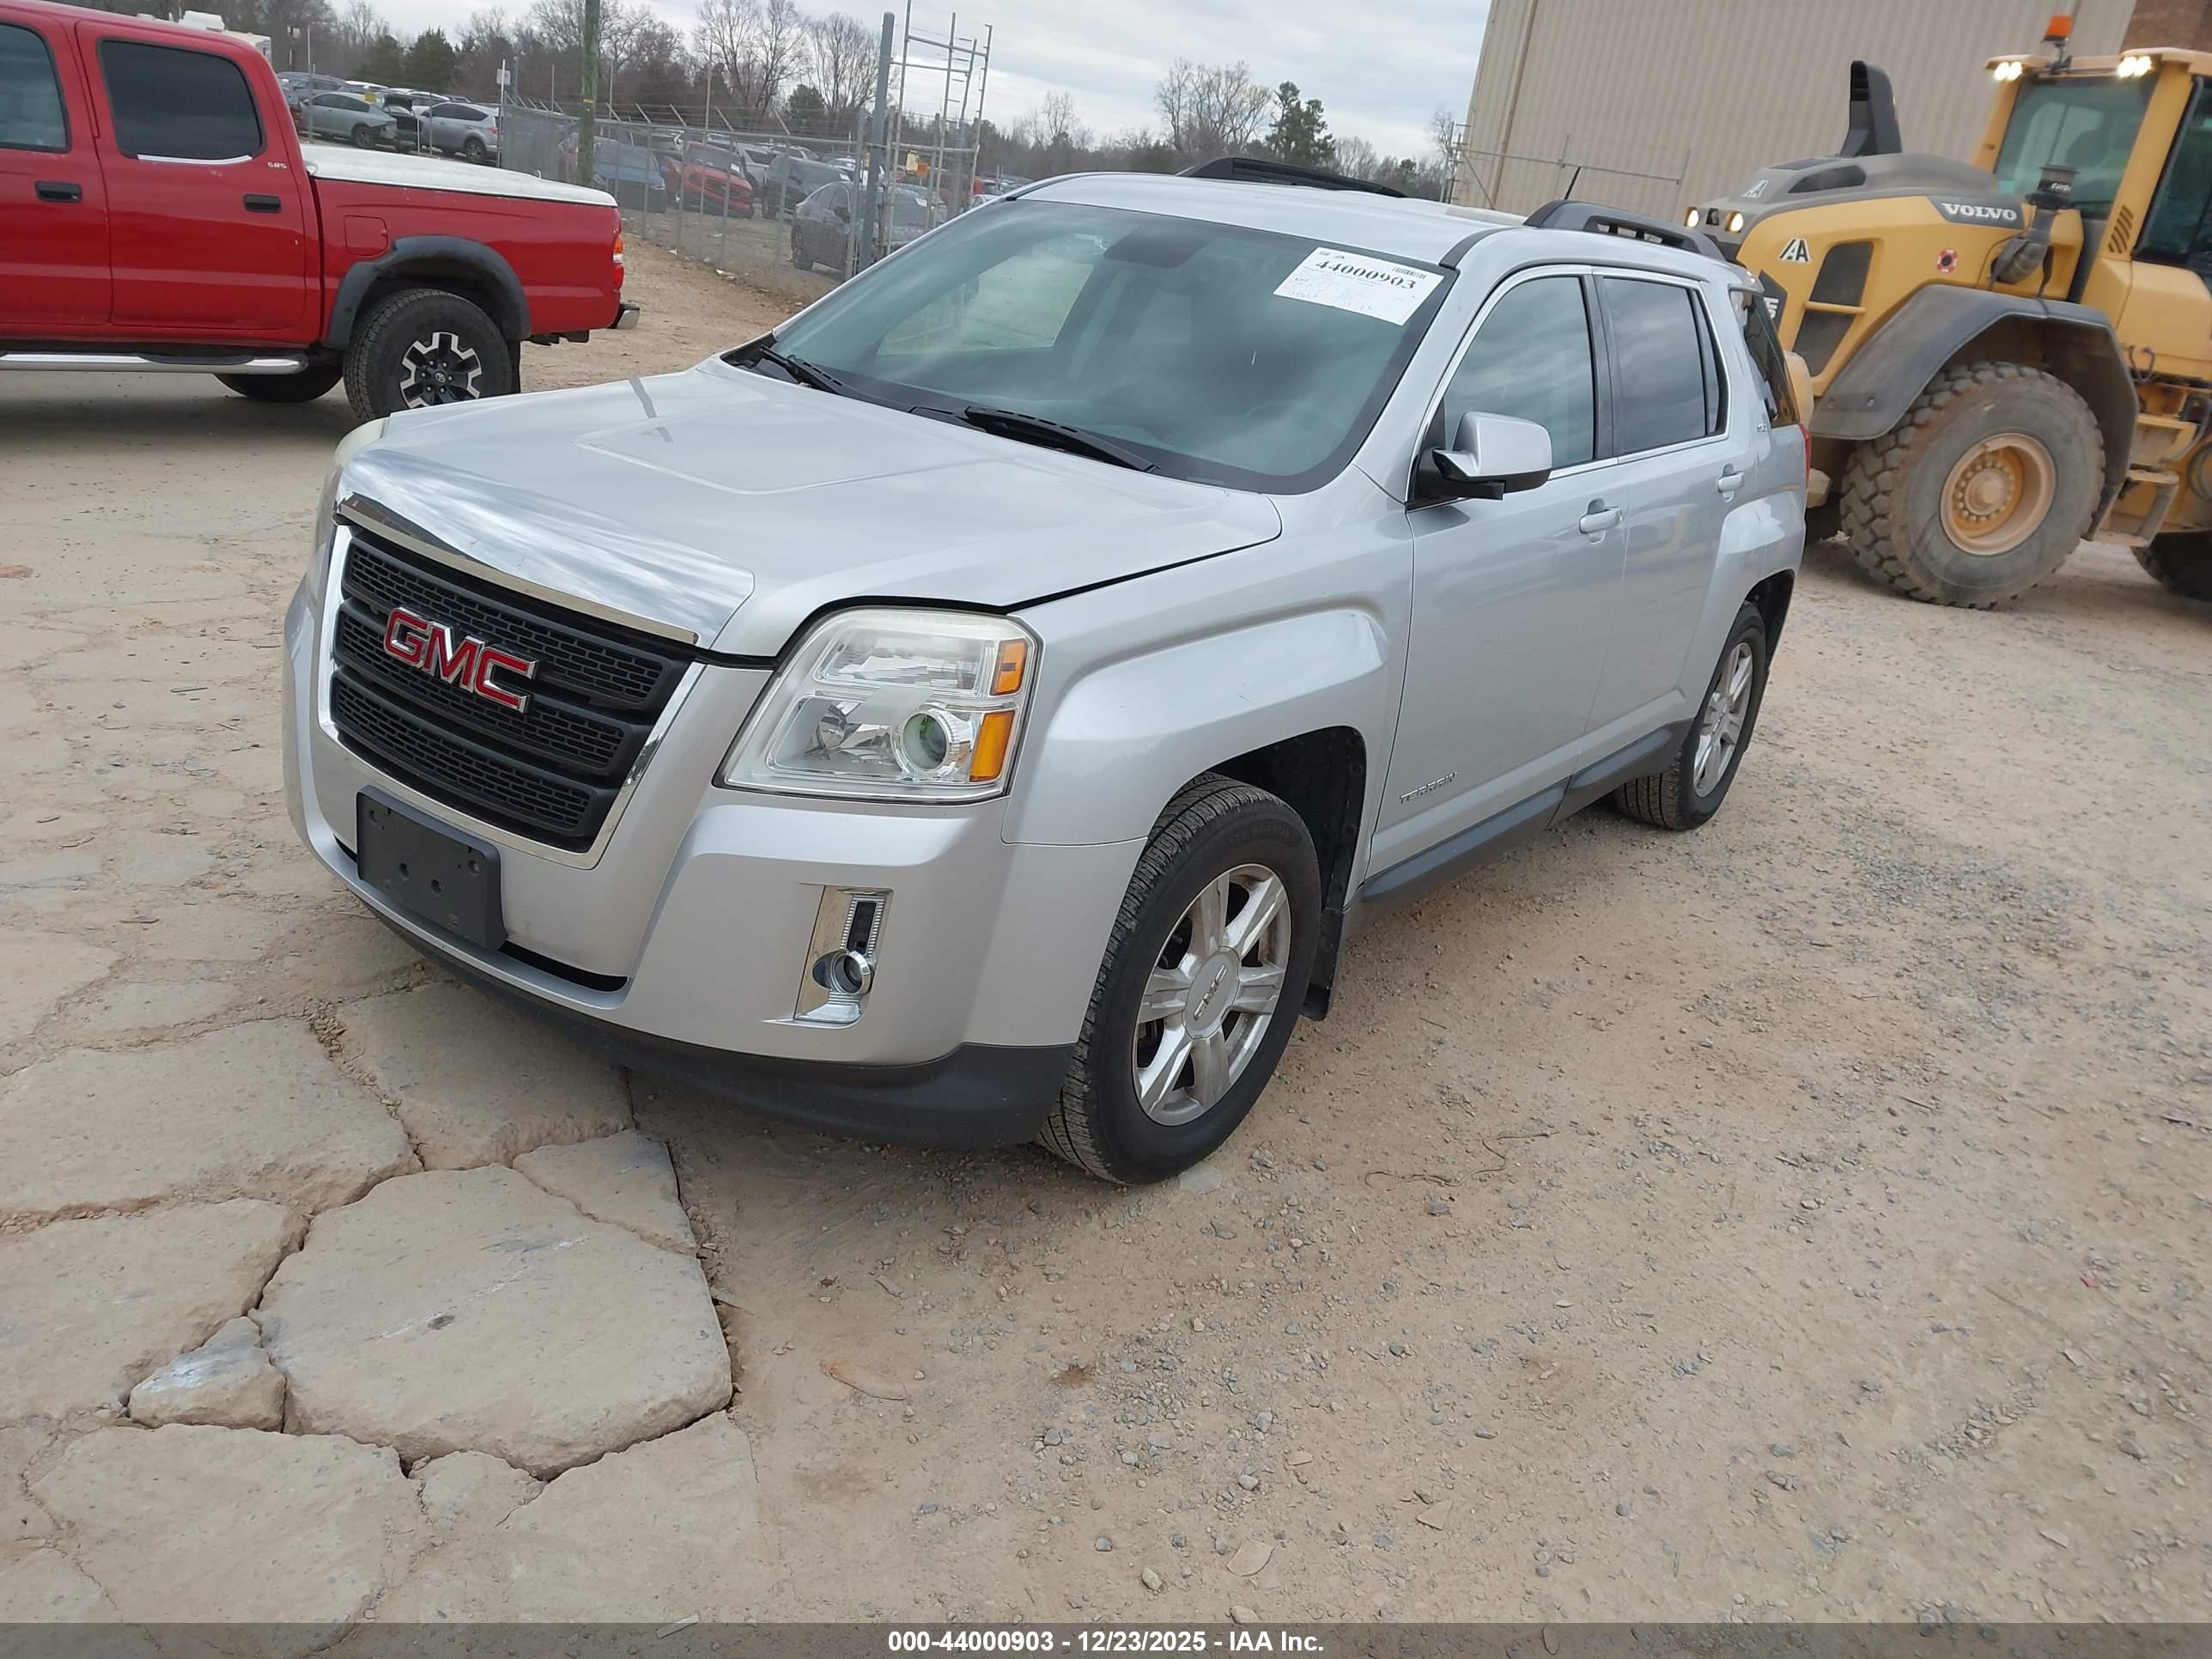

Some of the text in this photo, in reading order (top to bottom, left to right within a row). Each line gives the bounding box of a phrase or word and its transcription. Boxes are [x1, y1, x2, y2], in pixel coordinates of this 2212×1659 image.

[1942, 203, 2017, 221] VOLVO
[1316, 260, 1417, 290] 44000903
[384, 605, 538, 714] GMC
[1194, 963, 1228, 1021] GMC
